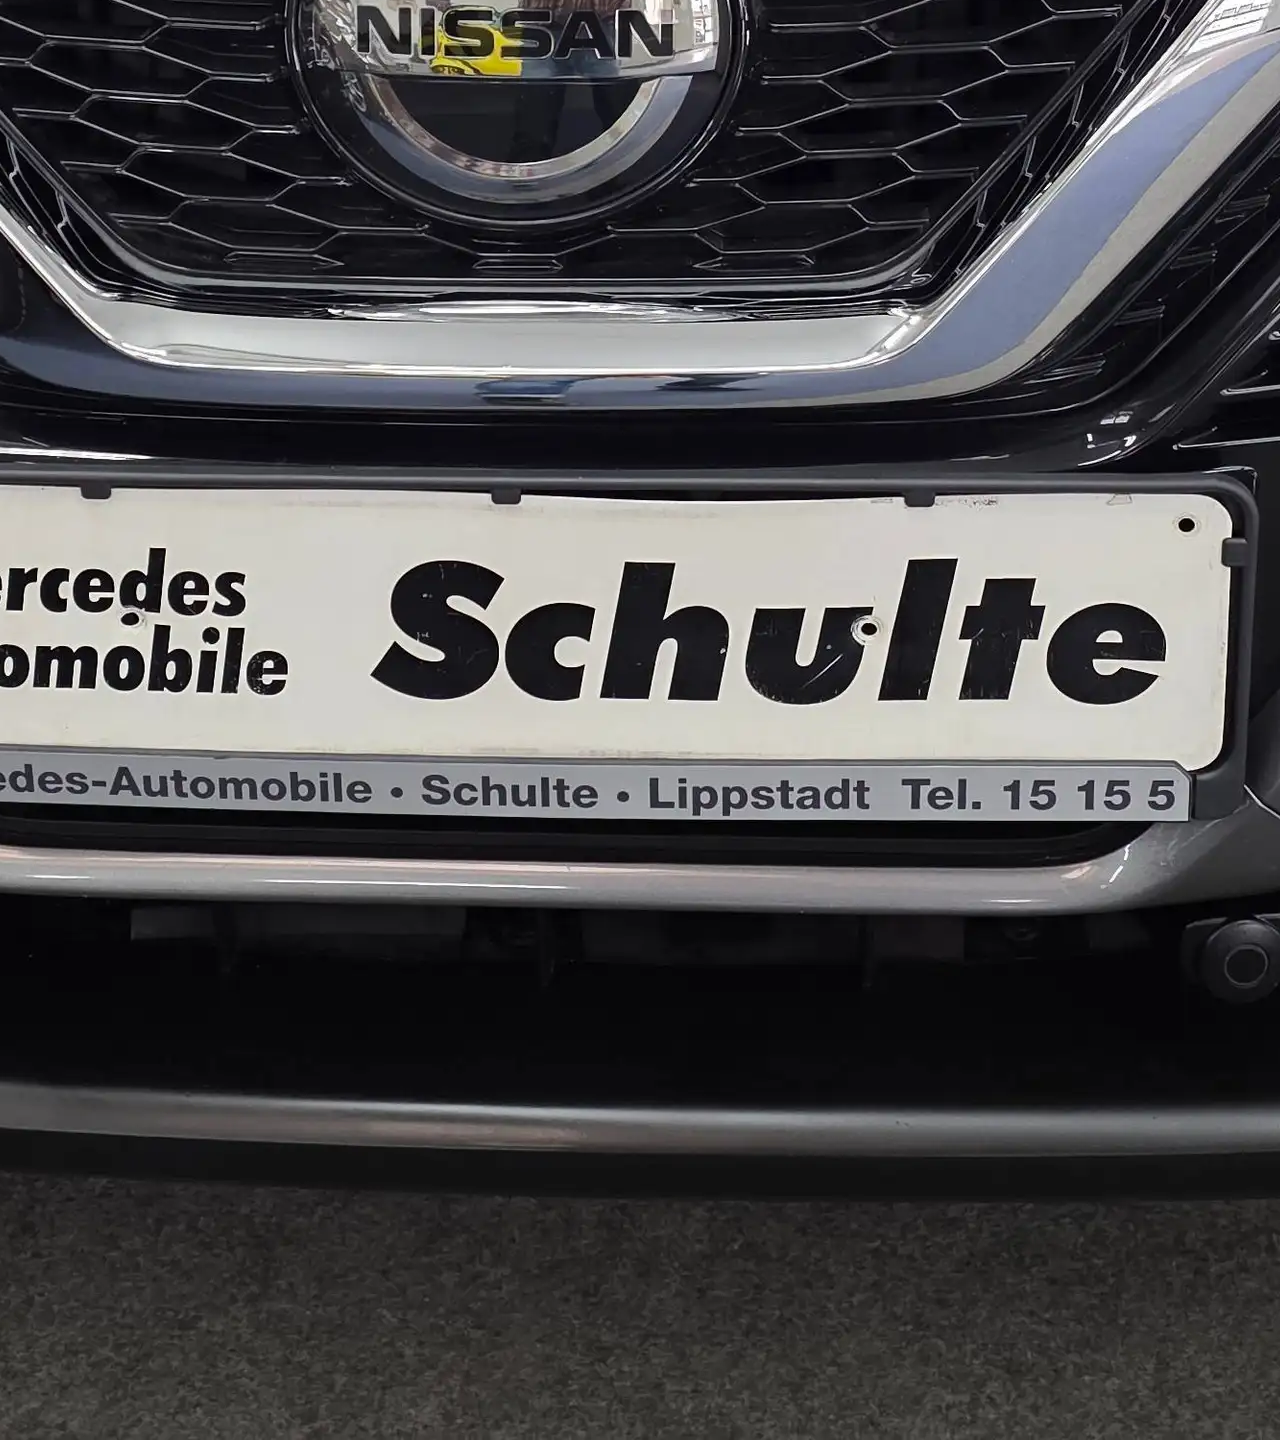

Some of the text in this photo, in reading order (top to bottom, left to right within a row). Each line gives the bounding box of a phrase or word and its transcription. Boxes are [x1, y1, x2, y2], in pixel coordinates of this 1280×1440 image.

[356, 5, 675, 60] NISSAN
[369, 558, 1168, 706] Schulte
[421, 774, 599, 809] Schulte
[649, 777, 871, 817] Lippstadt
[901, 778, 982, 811] Tel.
[1003, 779, 1057, 811] 15
[1077, 779, 1132, 811] 15
[1147, 779, 1176, 811] 5
